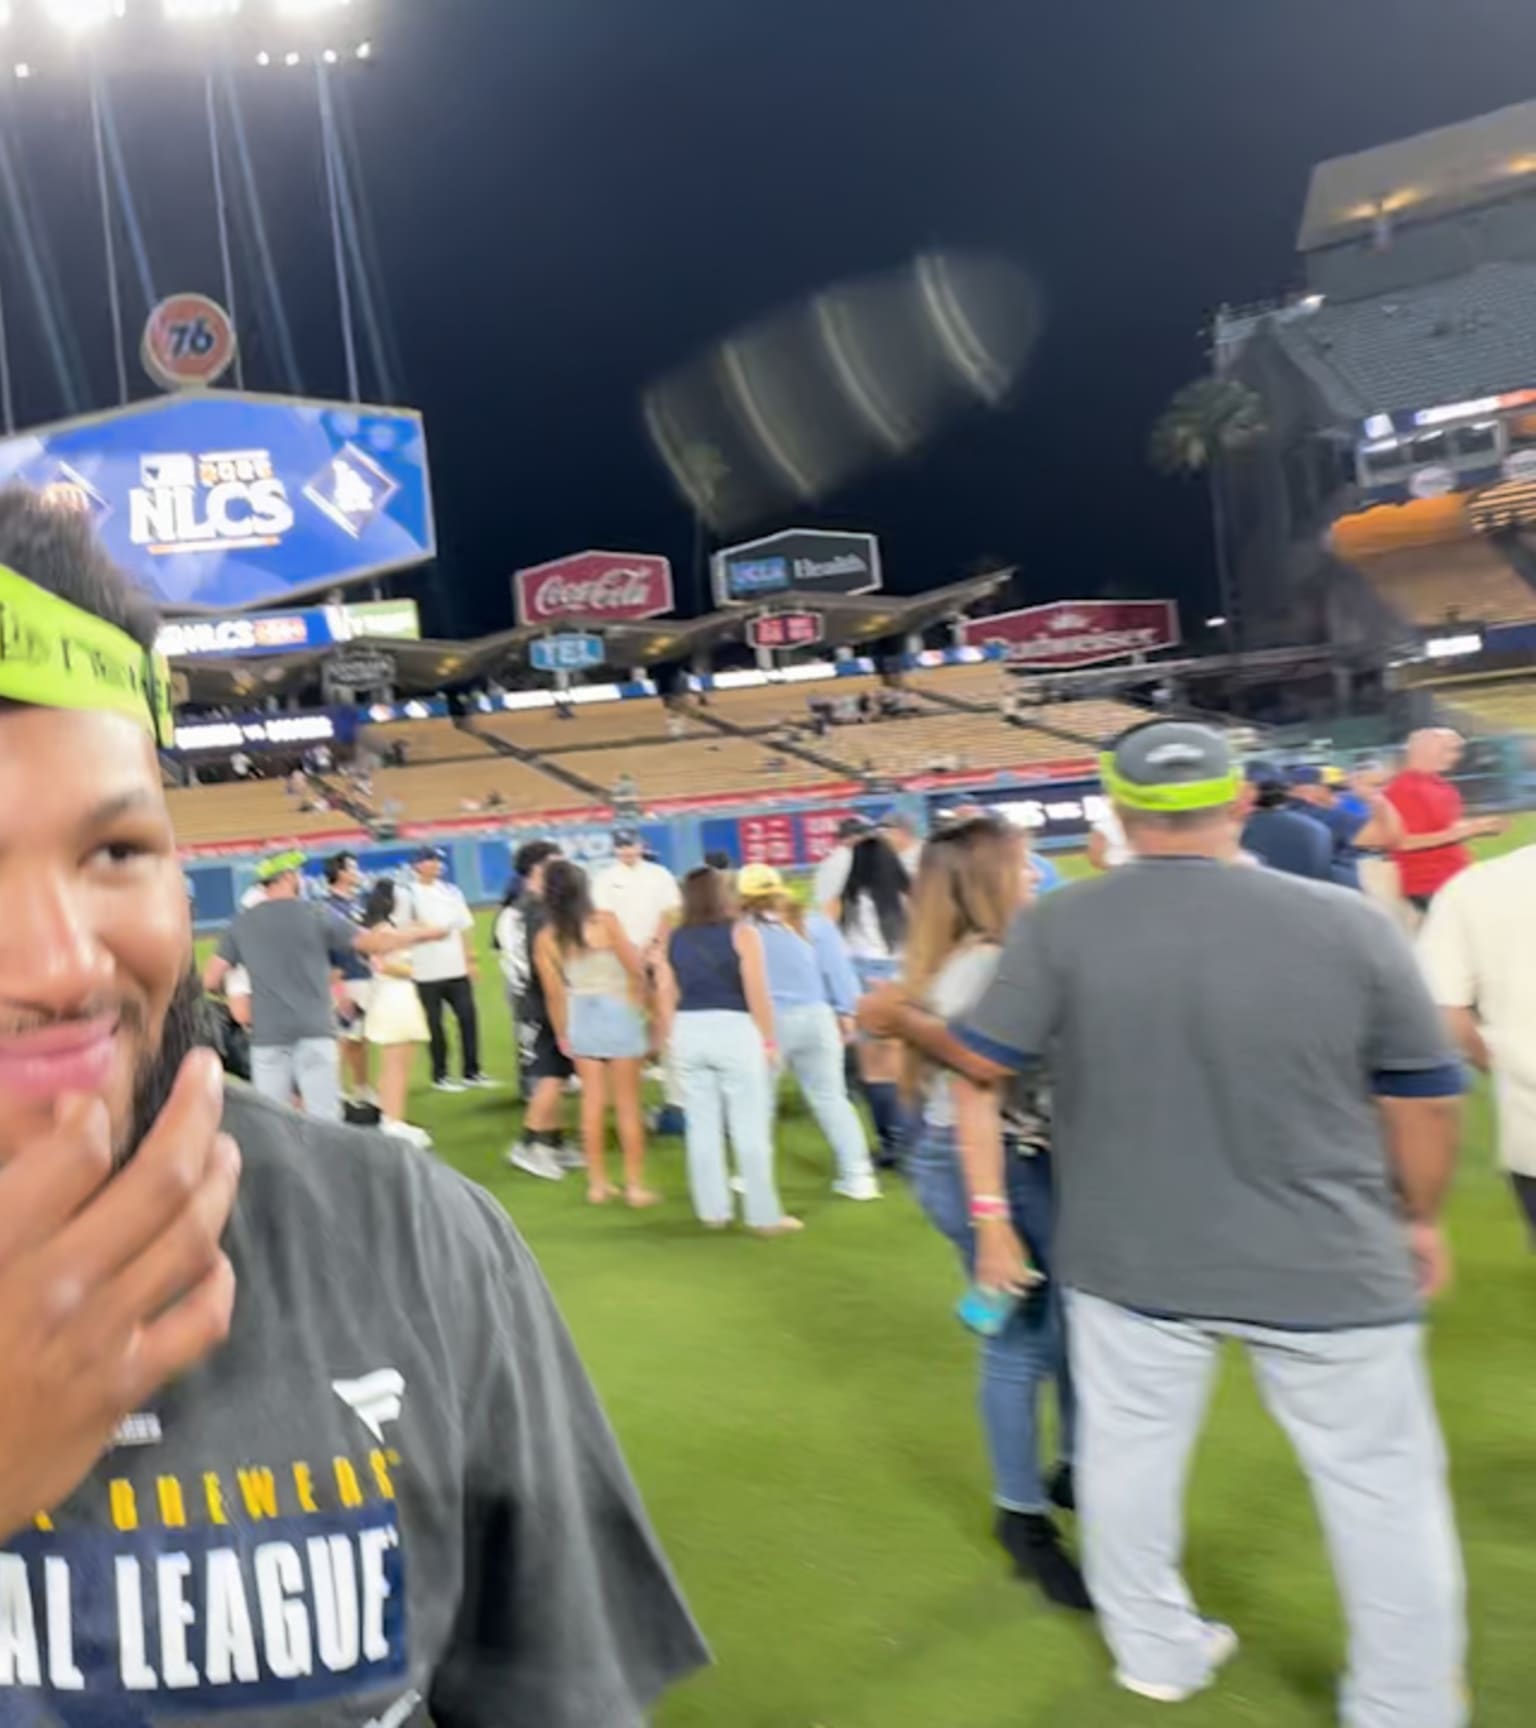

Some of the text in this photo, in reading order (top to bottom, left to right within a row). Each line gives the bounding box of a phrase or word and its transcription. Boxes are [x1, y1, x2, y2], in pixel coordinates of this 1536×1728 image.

[168, 322, 215, 358] 76
[128, 481, 295, 544] NLCS
[793, 553, 867, 579] Health
[114, 1529, 391, 1691] LEAGUE
